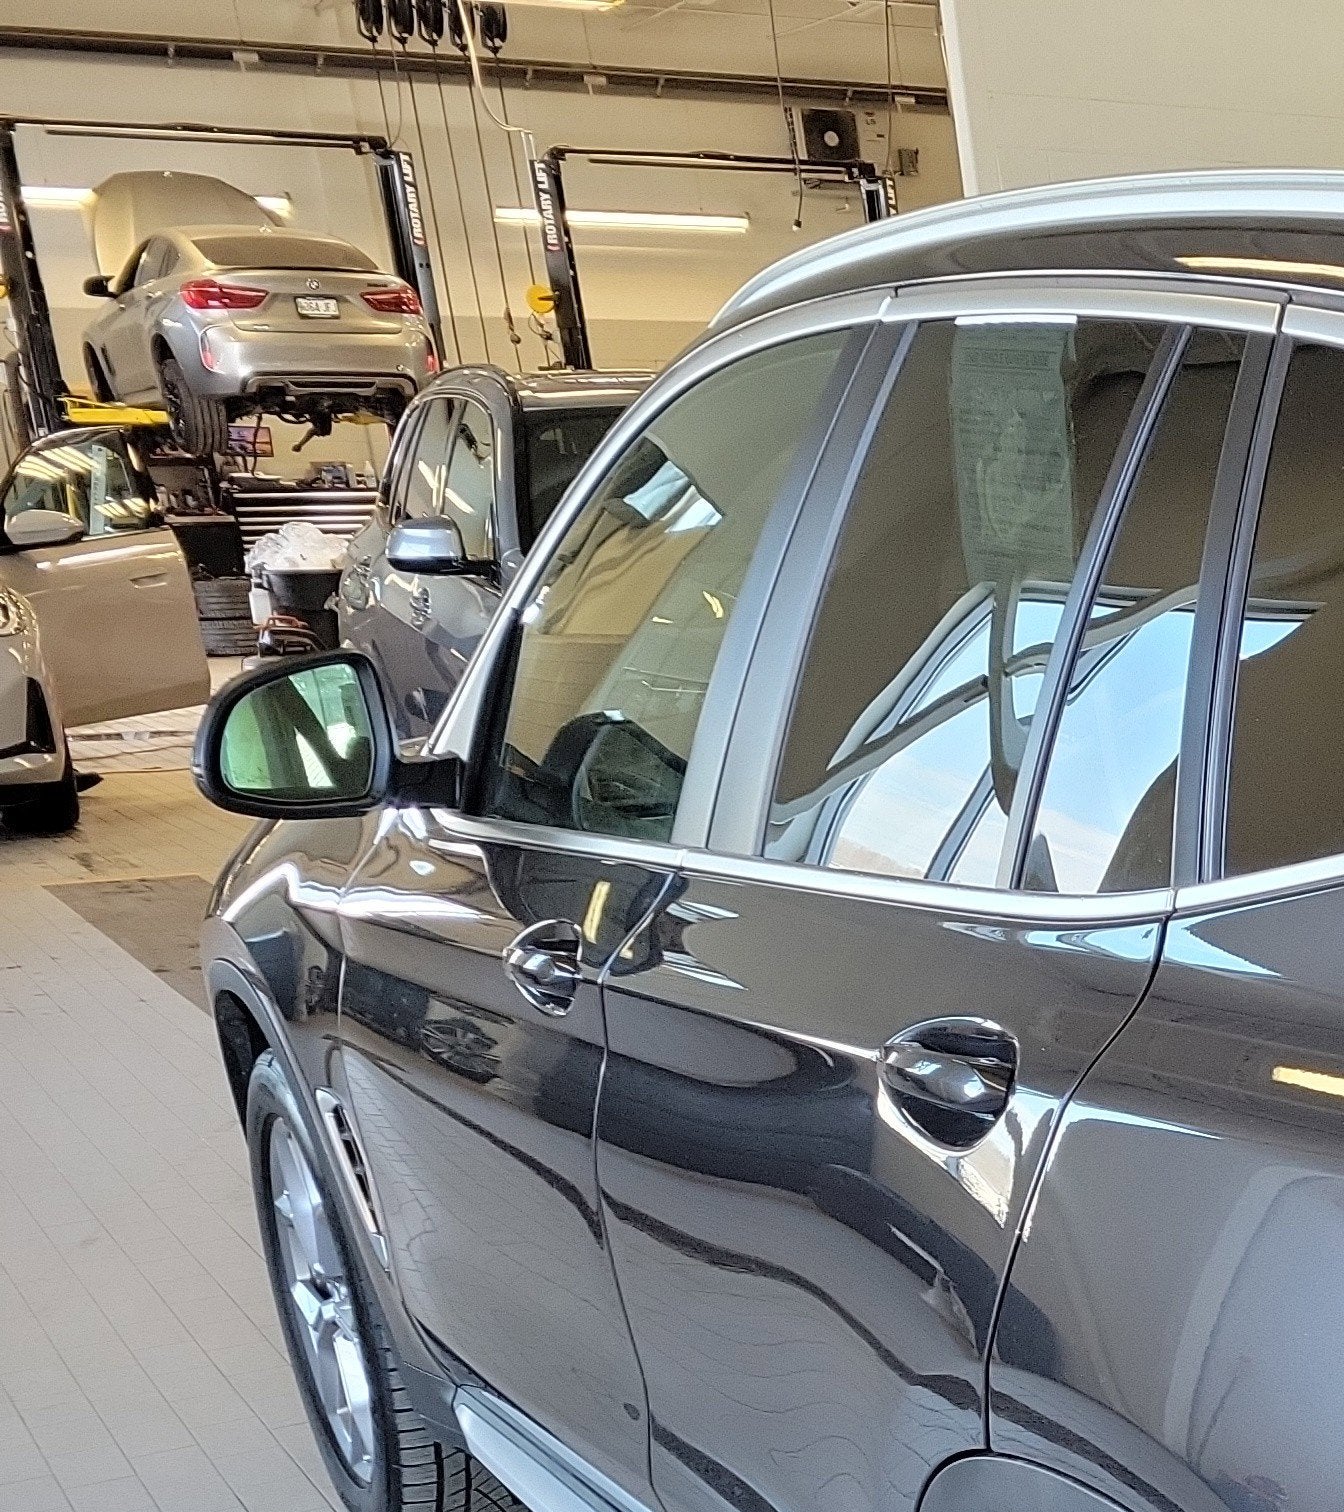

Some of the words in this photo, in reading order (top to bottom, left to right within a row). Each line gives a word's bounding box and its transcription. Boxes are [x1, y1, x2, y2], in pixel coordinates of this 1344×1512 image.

[400, 152, 415, 182] LIFT
[535, 162, 549, 189] LIFT
[405, 184, 425, 238] ROTARY
[540, 192, 560, 243] ROTARY
